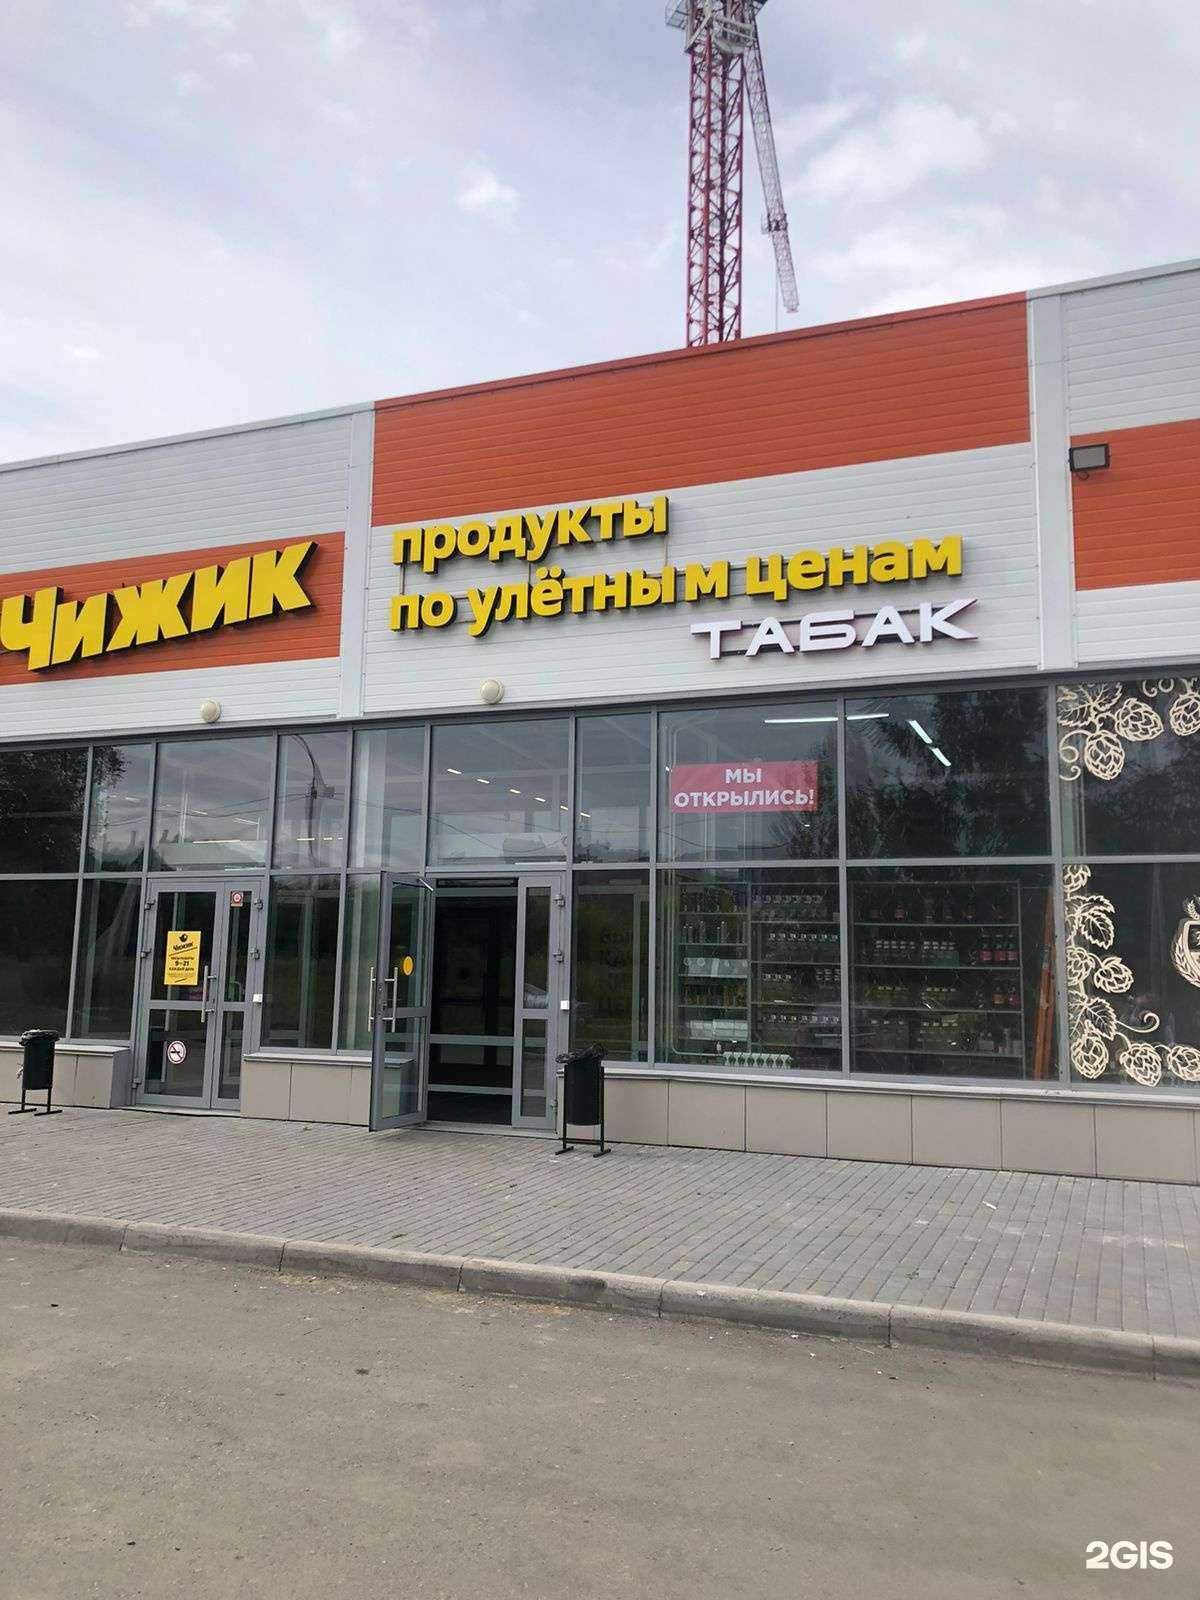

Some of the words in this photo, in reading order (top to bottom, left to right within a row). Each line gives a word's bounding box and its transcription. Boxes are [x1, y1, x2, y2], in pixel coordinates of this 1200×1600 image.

[391, 496, 668, 573] продукты
[390, 592, 453, 632] по
[466, 559, 729, 637] улётным
[745, 535, 963, 602] ценам
[691, 598, 978, 660] ТАБАК
[673, 789, 816, 808] ОТКРЫЛИСЬ!
[725, 768, 763, 784] МЫ
